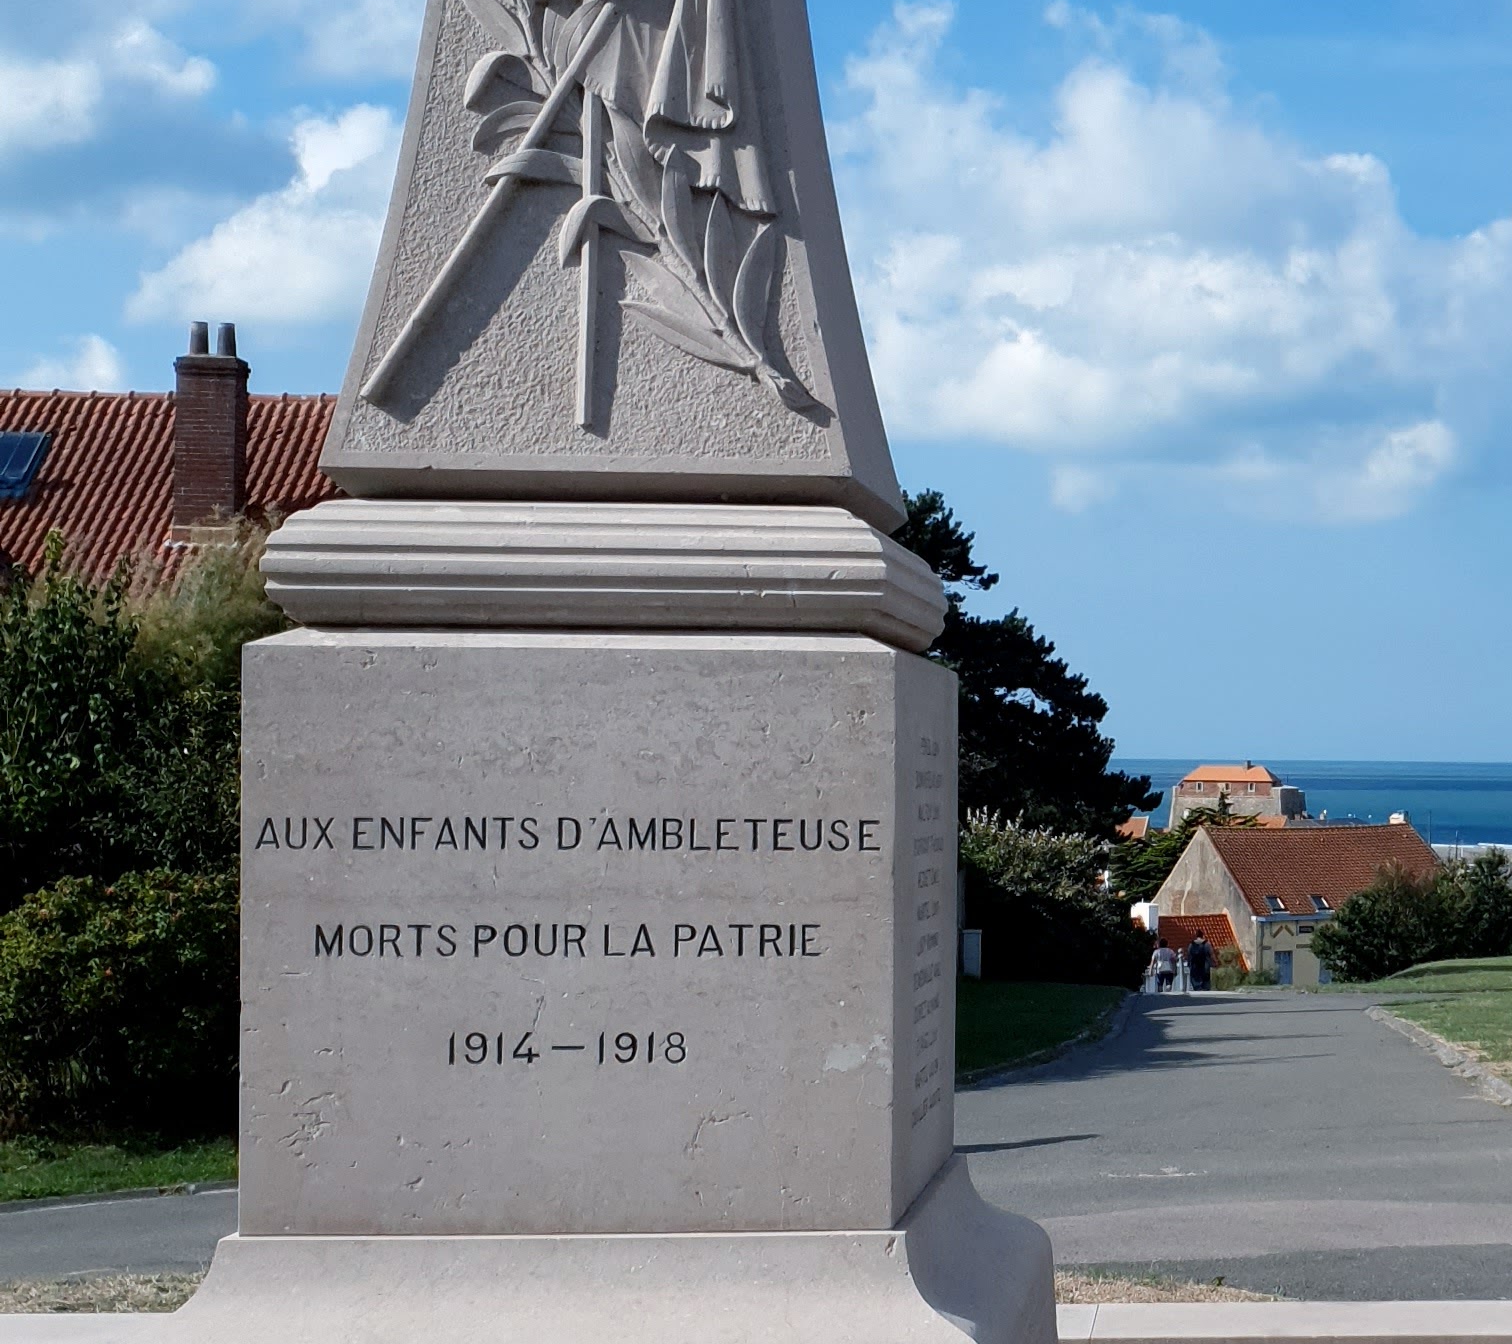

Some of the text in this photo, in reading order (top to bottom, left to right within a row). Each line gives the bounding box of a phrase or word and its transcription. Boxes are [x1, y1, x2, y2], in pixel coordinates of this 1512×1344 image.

[254, 816, 336, 851] AUX
[352, 816, 540, 852] ENFANTS
[557, 816, 882, 853] D'AMBLETEUSE
[314, 922, 823, 958] MORTS POUR LA PATRIE
